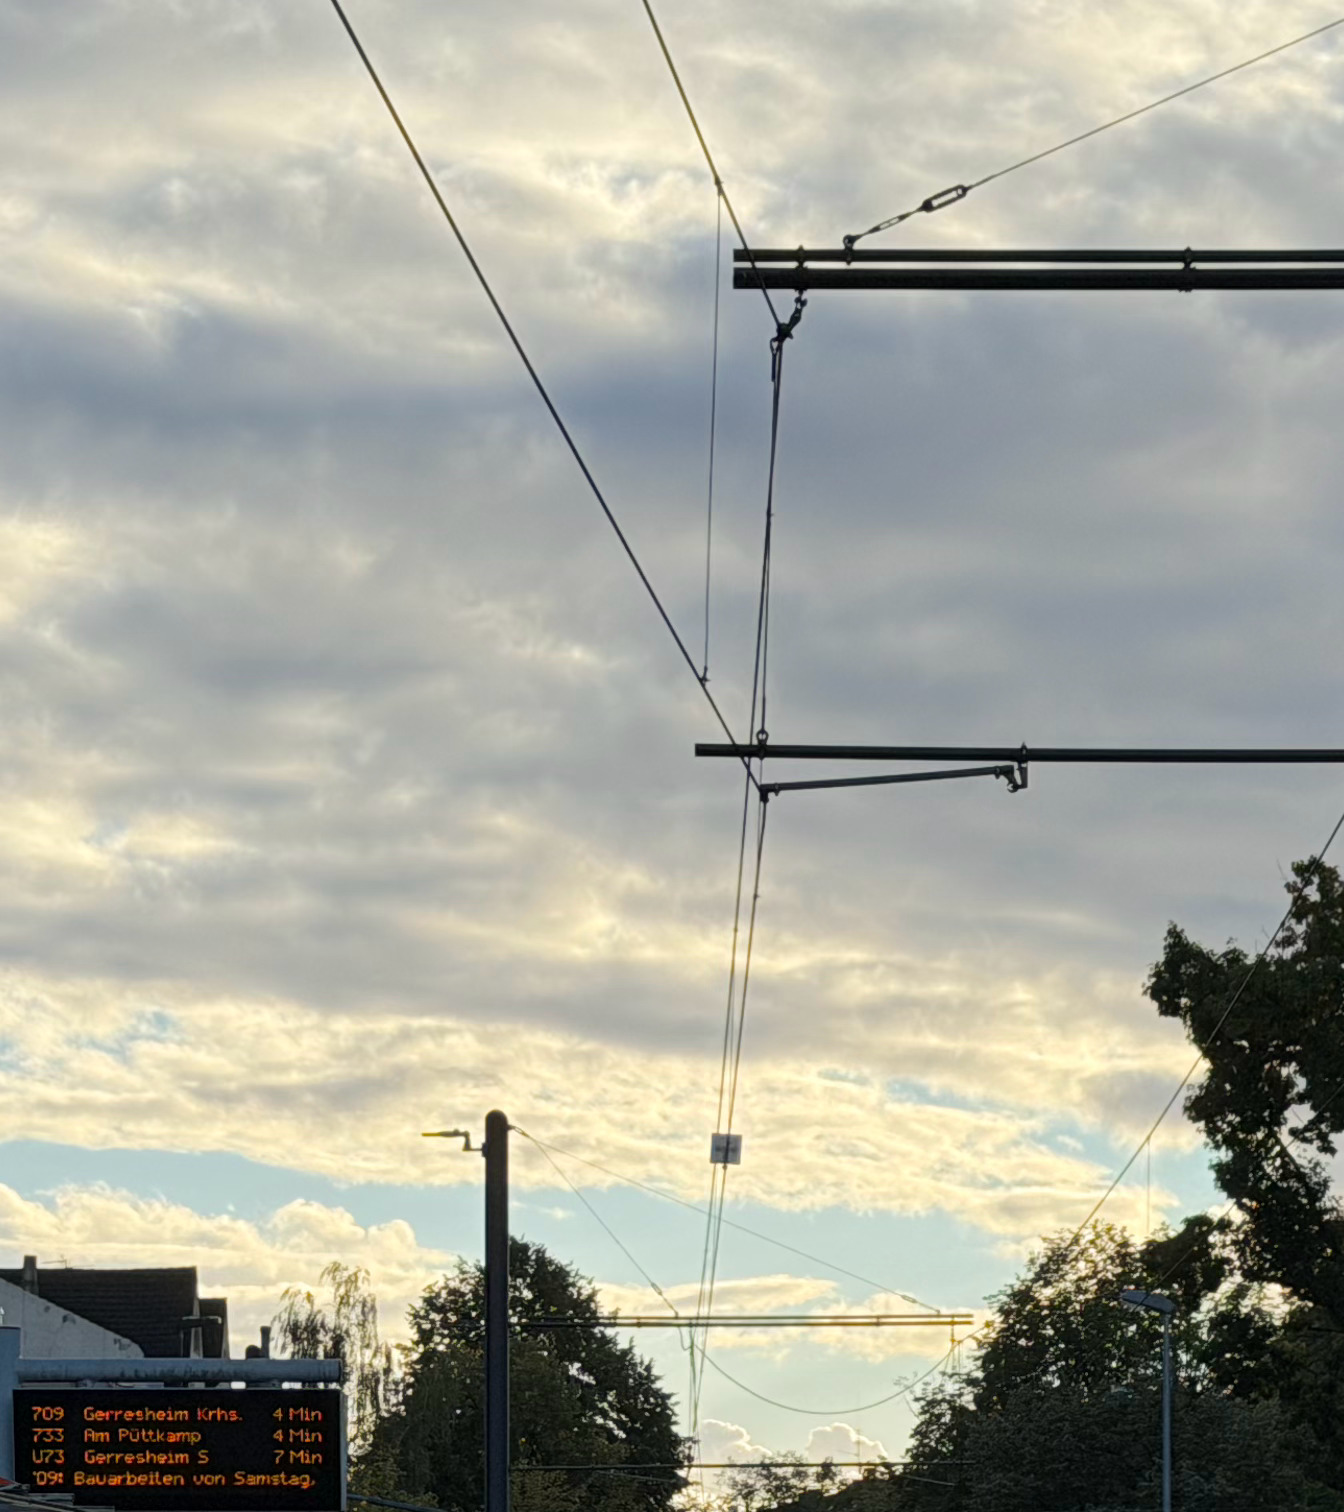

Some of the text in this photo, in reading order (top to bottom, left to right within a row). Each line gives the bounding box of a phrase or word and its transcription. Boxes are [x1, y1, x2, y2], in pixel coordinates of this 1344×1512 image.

[32, 1406, 322, 1421] 709 Gerresheim Krhs. 4 Min
[32, 1428, 323, 1446] 733 Am Püttkamp 4 Min
[32, 1449, 323, 1464] U73 Gerresheim S 7 Min
[74, 1471, 184, 1486] Bauarbeiten
[193, 1474, 225, 1486] von
